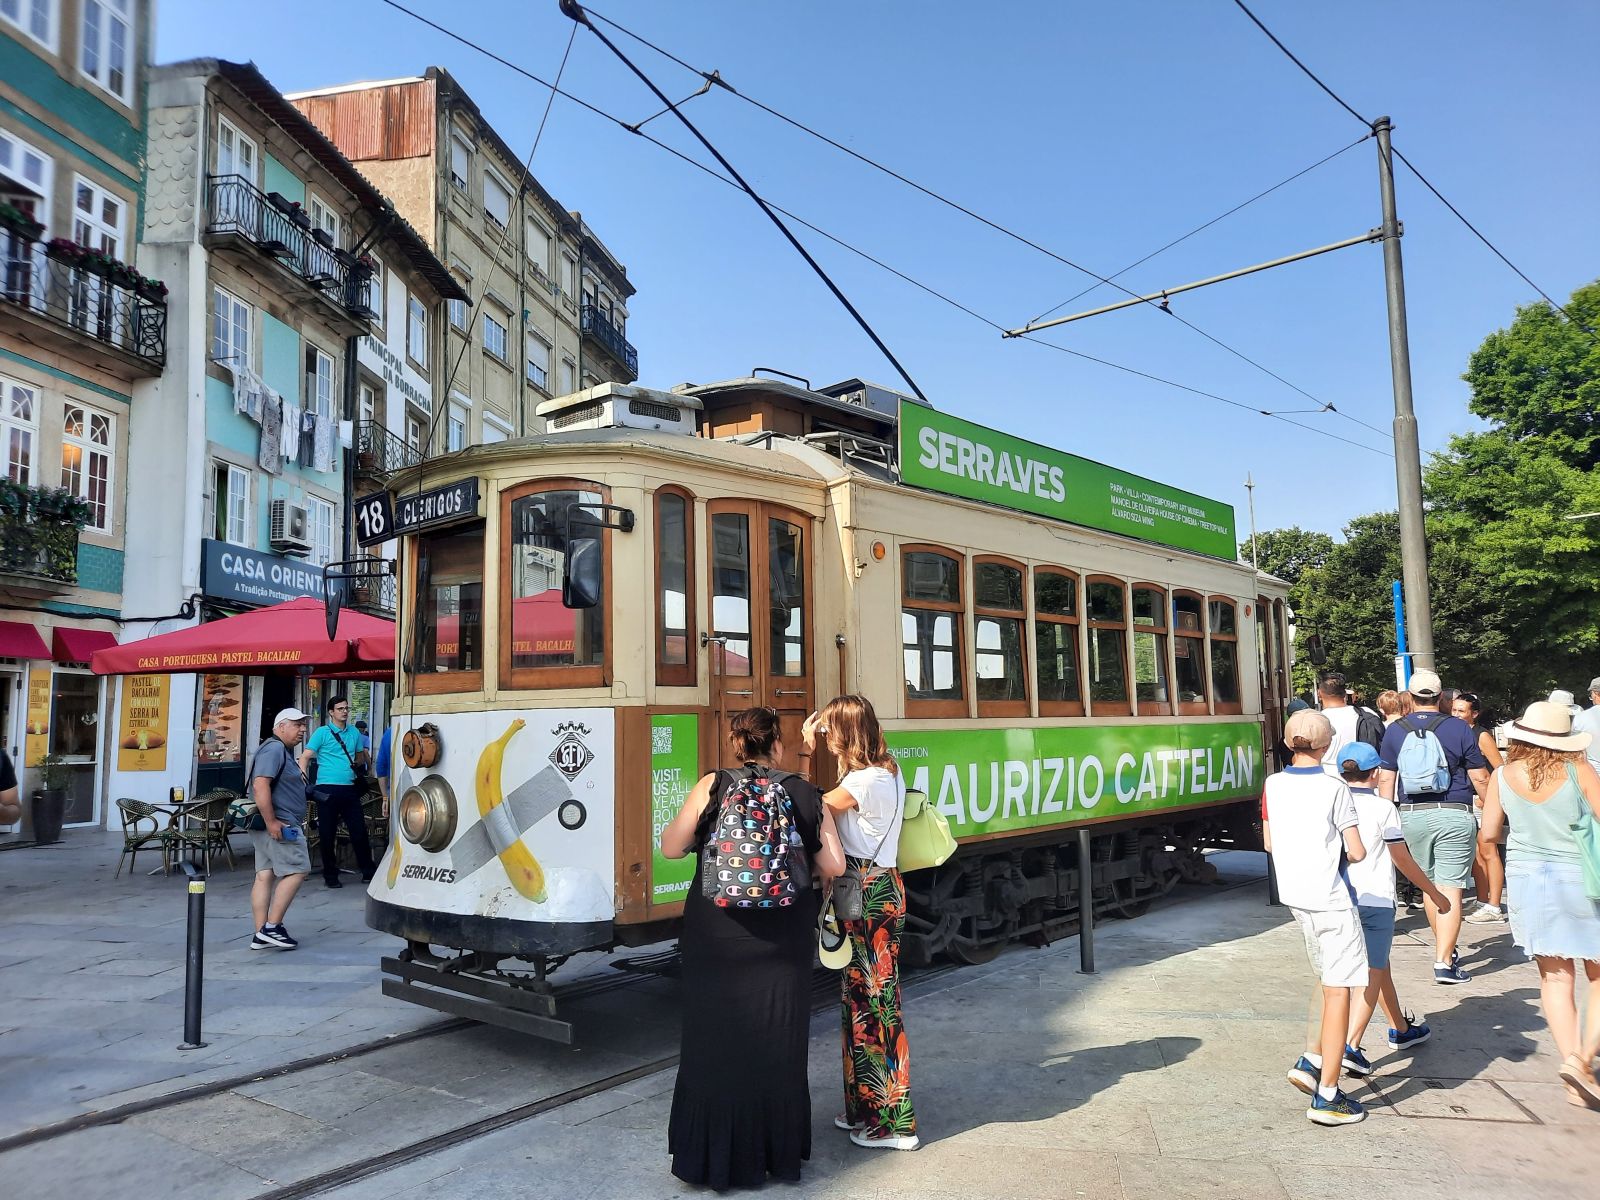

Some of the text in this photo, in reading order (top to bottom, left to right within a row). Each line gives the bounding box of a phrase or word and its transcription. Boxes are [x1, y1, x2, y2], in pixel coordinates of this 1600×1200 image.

[365, 336, 403, 376] PRINCIPAL
[383, 365, 431, 414] DA BORRACHA
[360, 500, 385, 537] 18
[221, 553, 337, 596] CASA ORIENTAL
[235, 582, 240, 592] A
[241, 583, 268, 597] Tradição
[138, 650, 301, 668] CASA PORTUGUESA PASTEL BACALHAU
[131, 677, 151, 686] PASTEL
[131, 687, 160, 697] BACALHAU
[130, 708, 159, 718] SERRA DA
[653, 768, 681, 782] VISIT
[1114, 745, 1254, 804] CATTELAN
[654, 780, 691, 795] US ALL
[654, 794, 685, 809] YEAR
